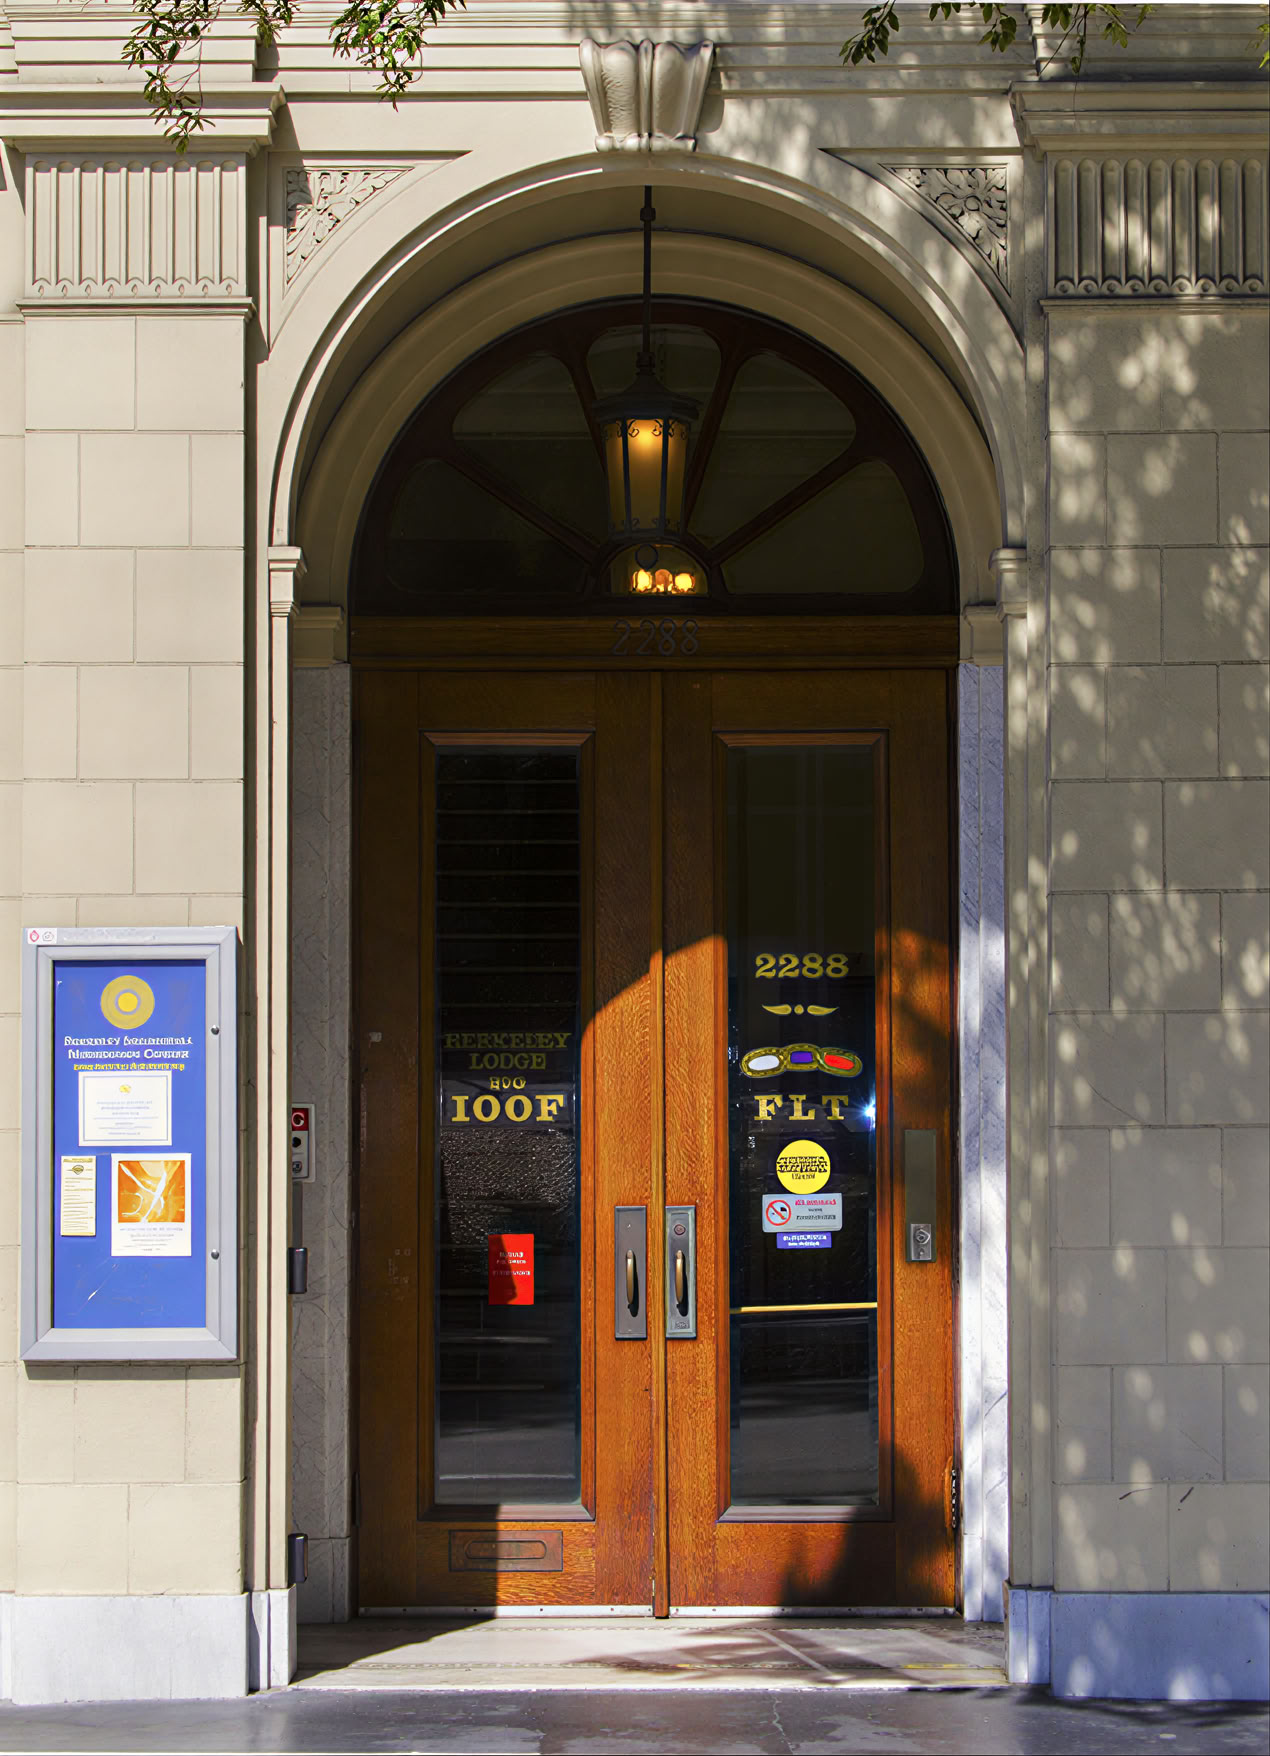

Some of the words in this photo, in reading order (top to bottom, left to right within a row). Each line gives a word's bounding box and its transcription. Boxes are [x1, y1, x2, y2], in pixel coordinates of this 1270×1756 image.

[612, 617, 699, 656] 2288
[755, 952, 849, 979] 2288
[443, 1032, 572, 1049] BERKELEY
[468, 1052, 547, 1070] LODGE
[451, 1094, 565, 1123] IOOF
[753, 1094, 849, 1121] FLT
